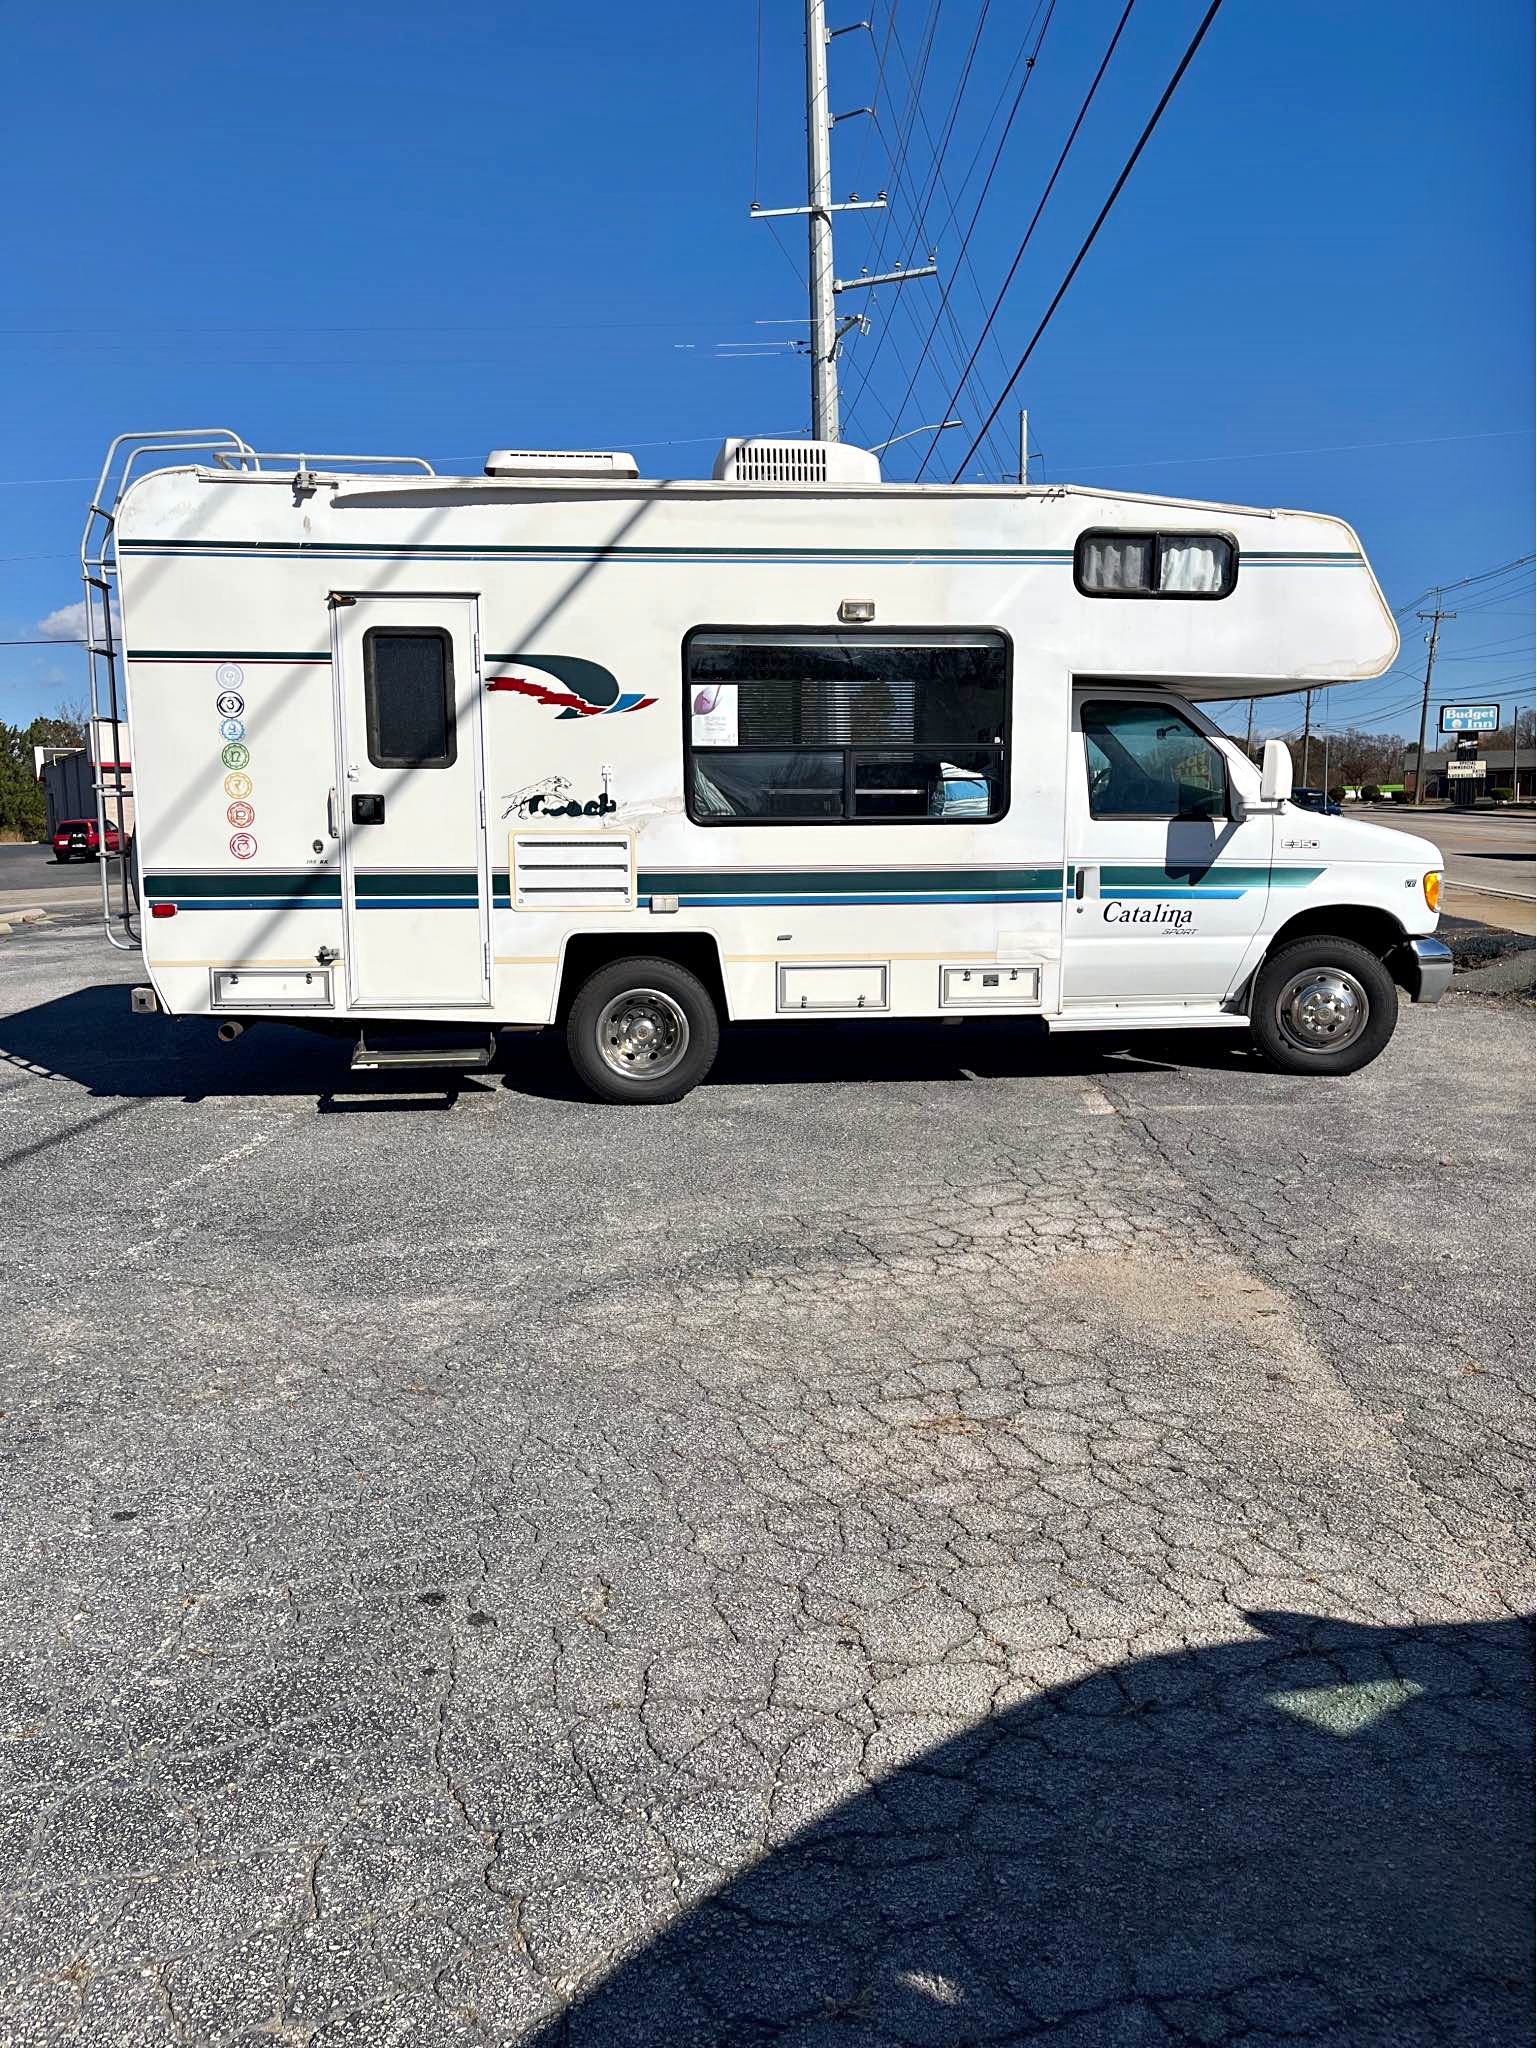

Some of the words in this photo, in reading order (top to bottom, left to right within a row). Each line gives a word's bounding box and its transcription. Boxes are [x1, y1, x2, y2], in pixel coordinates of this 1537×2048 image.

[1446, 709, 1494, 720] Budget
[1467, 719, 1492, 729] Inn
[1103, 901, 1193, 928] Catalina
[1162, 928, 1199, 936] SPORT
